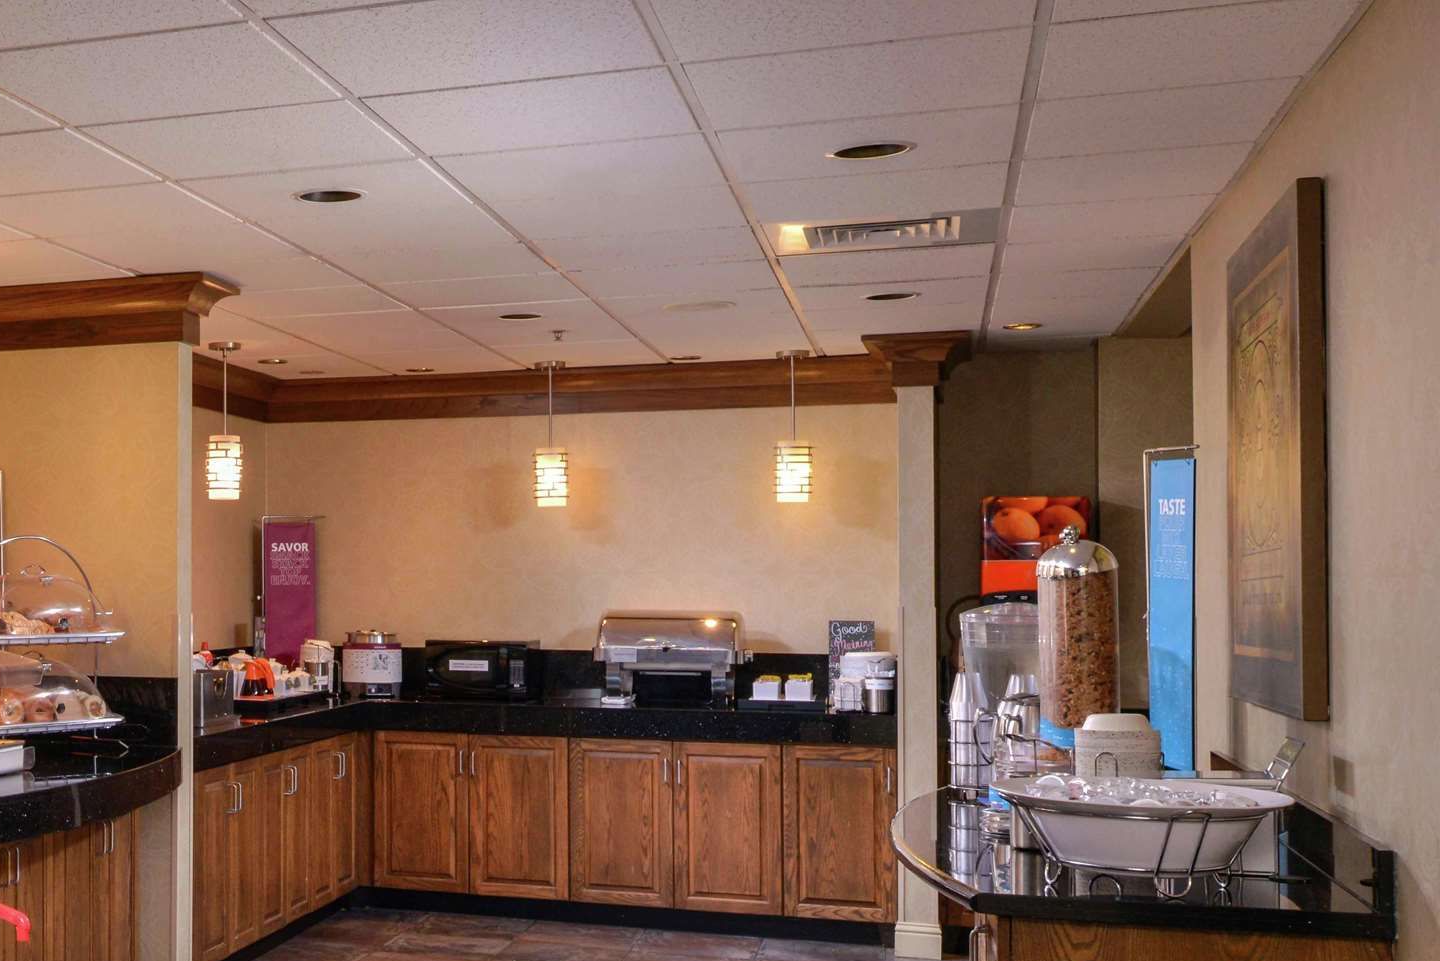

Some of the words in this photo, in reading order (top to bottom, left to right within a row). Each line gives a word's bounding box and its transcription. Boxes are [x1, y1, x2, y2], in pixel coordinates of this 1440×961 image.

[1158, 498, 1186, 516] TASTE
[271, 542, 309, 552] SAVOR
[831, 622, 868, 640] Good
